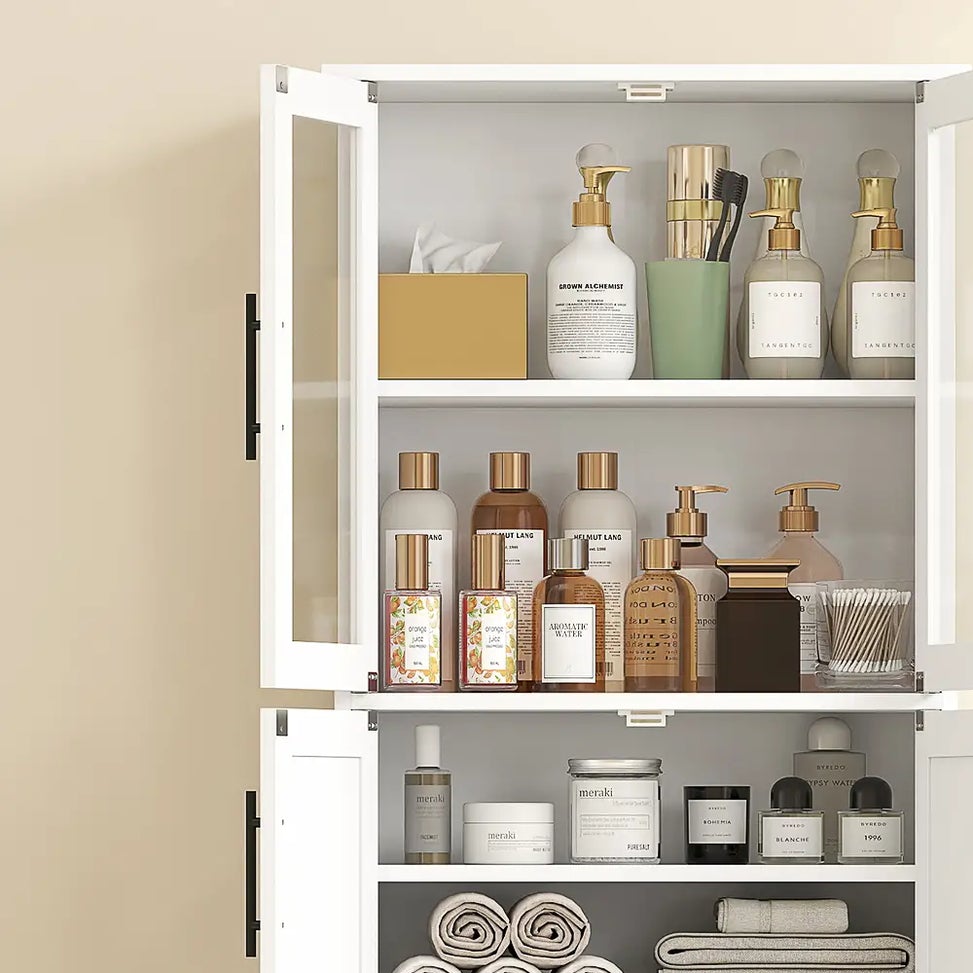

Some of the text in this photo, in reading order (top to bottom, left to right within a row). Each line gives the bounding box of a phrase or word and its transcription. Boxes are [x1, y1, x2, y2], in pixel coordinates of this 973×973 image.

[579, 787, 613, 797] meraki
[416, 794, 445, 803] meraki
[487, 830, 516, 840] meraki
